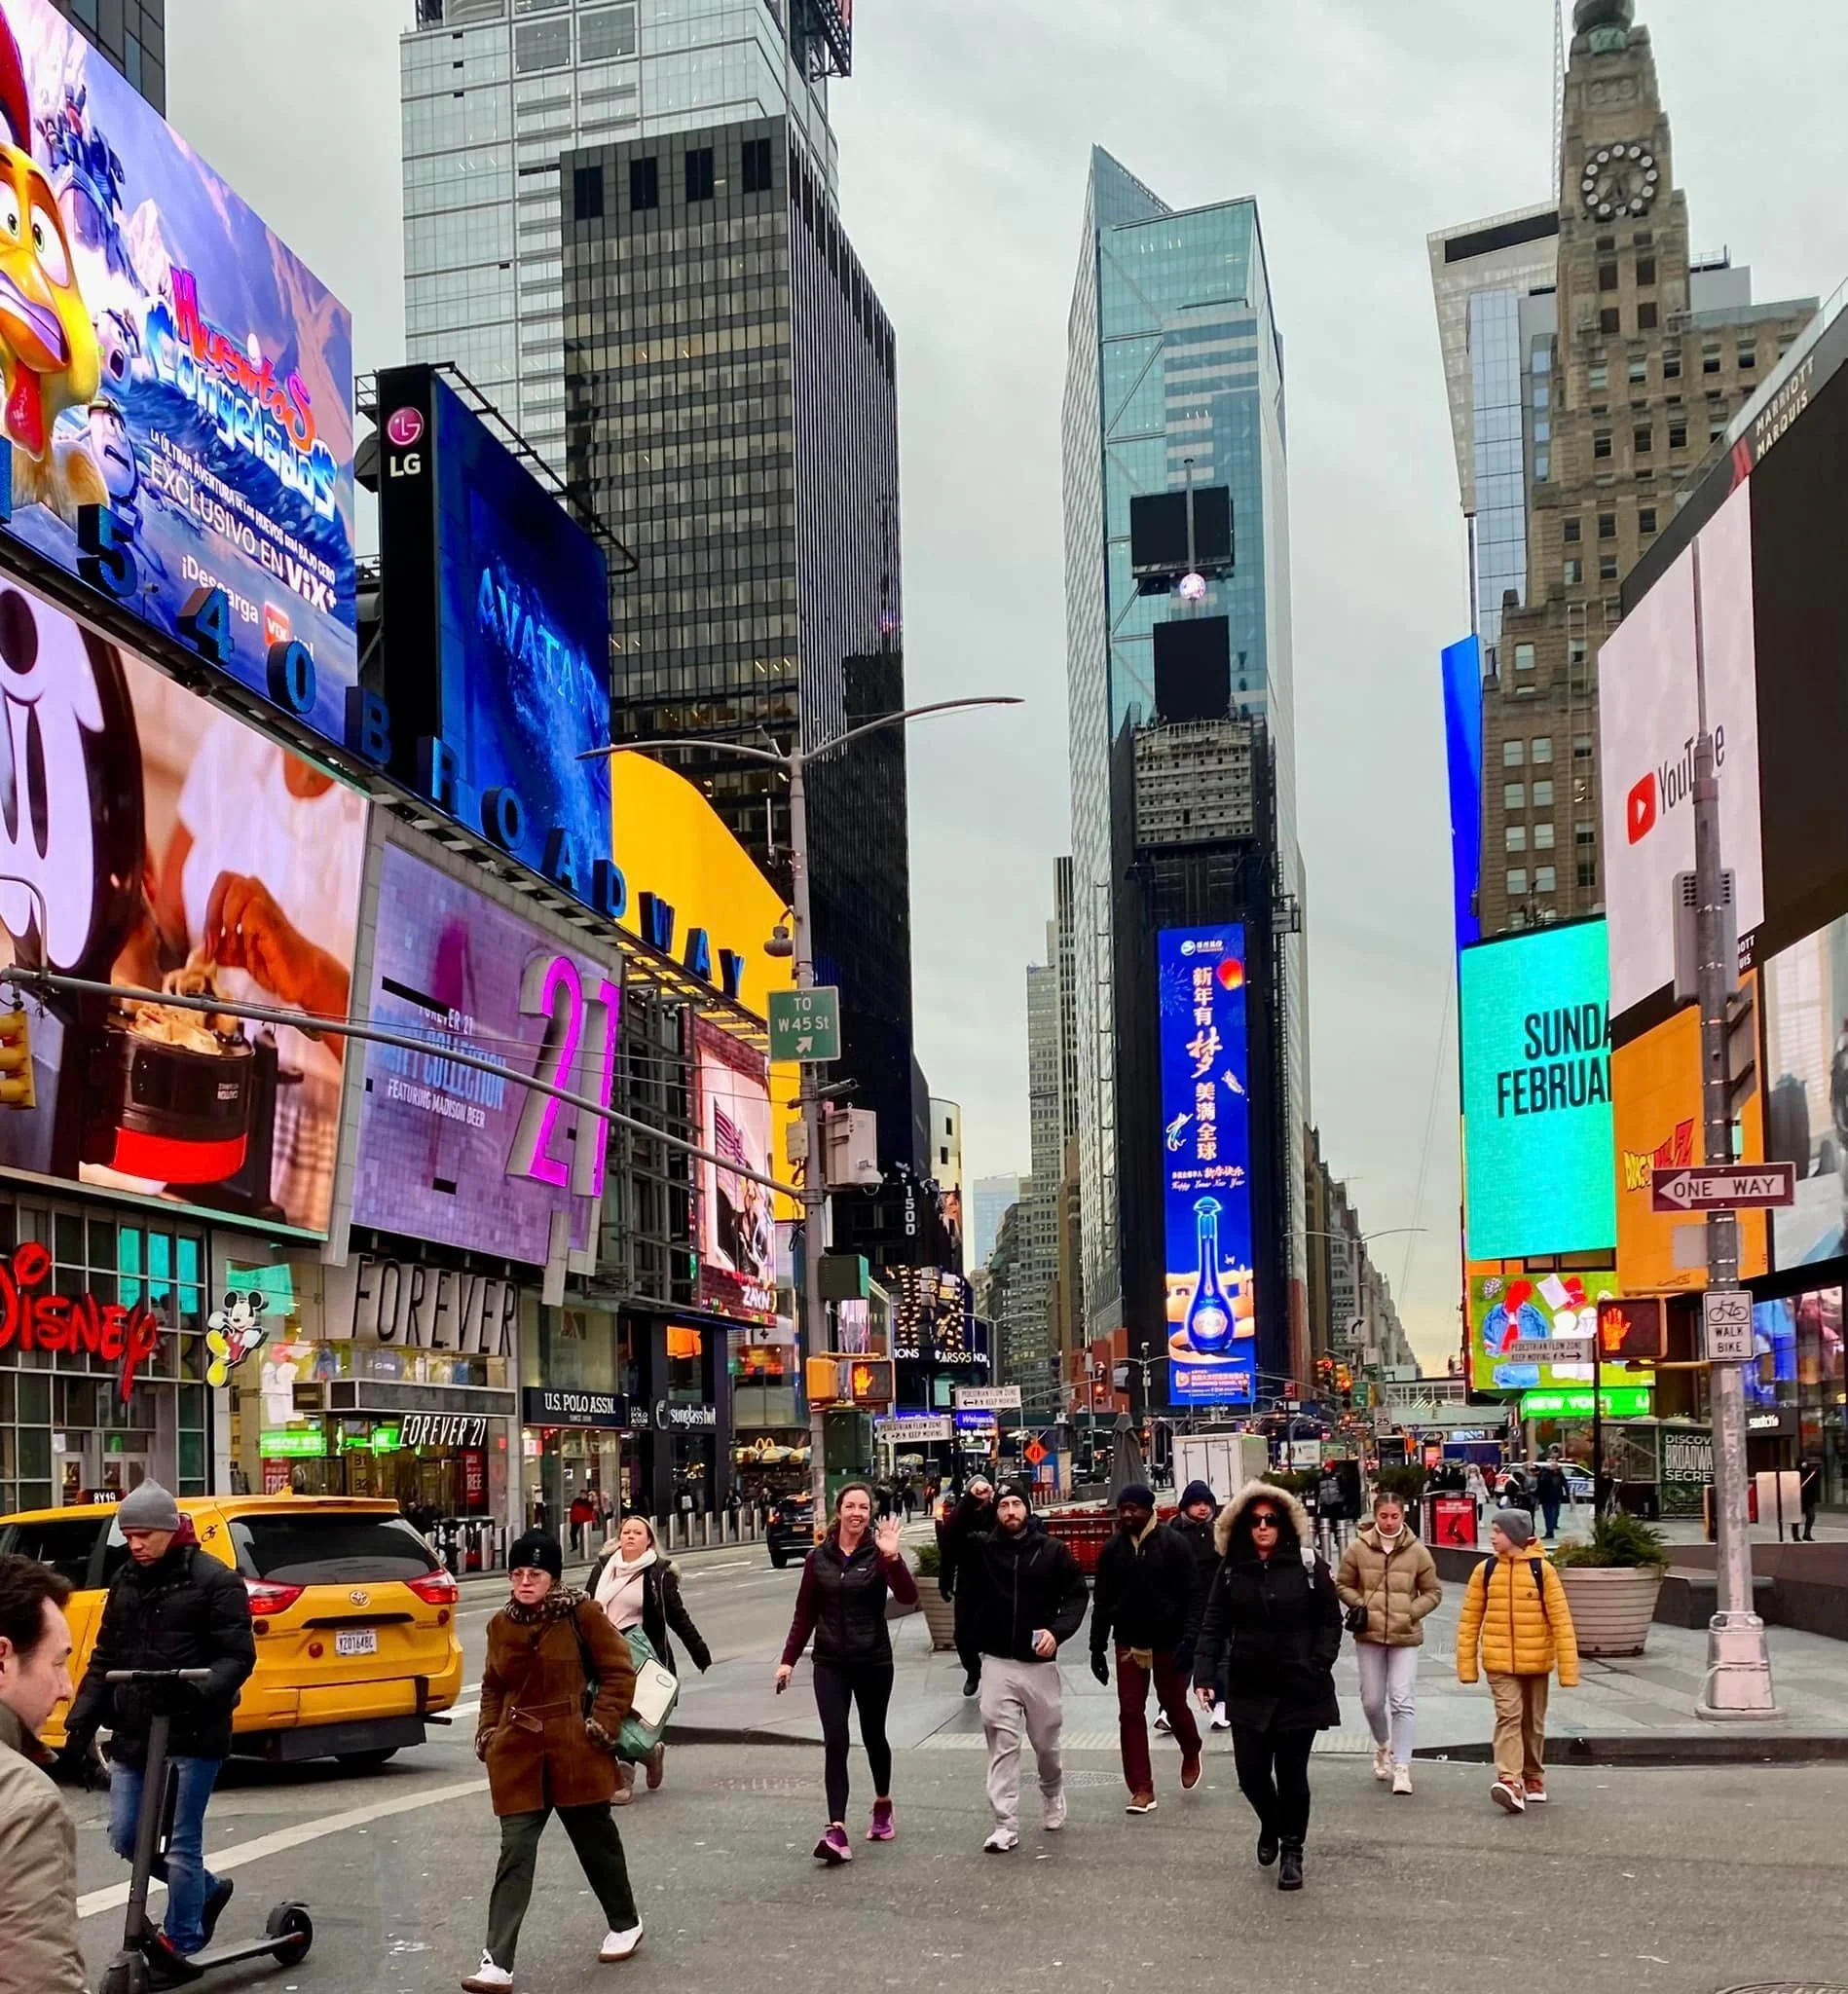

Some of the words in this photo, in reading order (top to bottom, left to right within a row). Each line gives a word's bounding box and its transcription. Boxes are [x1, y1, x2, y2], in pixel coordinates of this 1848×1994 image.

[1756, 354, 1814, 437] MARRIOTT
[1756, 389, 1809, 461] MARQUIS
[194, 462, 236, 506] AVENTURA
[390, 454, 421, 478] LG
[151, 454, 255, 555] EXCLUSIVO
[260, 537, 283, 578] EN
[1658, 724, 1724, 815] YouTe
[346, 685, 746, 1000] BROADWAY
[778, 1018, 790, 1032] W
[792, 1017, 812, 1031] 45
[814, 1016, 830, 1031] St
[794, 997, 812, 1012] TO
[521, 955, 620, 1199] 21
[1497, 1054, 1612, 1120] FEBRUA
[388, 1078, 431, 1110] FEATURING
[431, 1092, 467, 1124] MADISON
[466, 1104, 486, 1128] BEER
[1674, 1180, 1713, 1198] ONE
[1733, 1177, 1776, 1196] WAY
[906, 1185, 916, 1236] 1500
[351, 1253, 517, 1357] FOREVER
[741, 1285, 771, 1311] ZAYN
[1715, 1326, 1744, 1338] WALK
[1717, 1342, 1743, 1353] BIKE
[544, 1392, 563, 1412] U.S.
[563, 1394, 588, 1413] POLO
[590, 1396, 615, 1415] ASSN.
[1376, 1418, 1390, 1426] 25
[400, 1415, 466, 1448] FOREVER
[470, 1418, 488, 1447] 21
